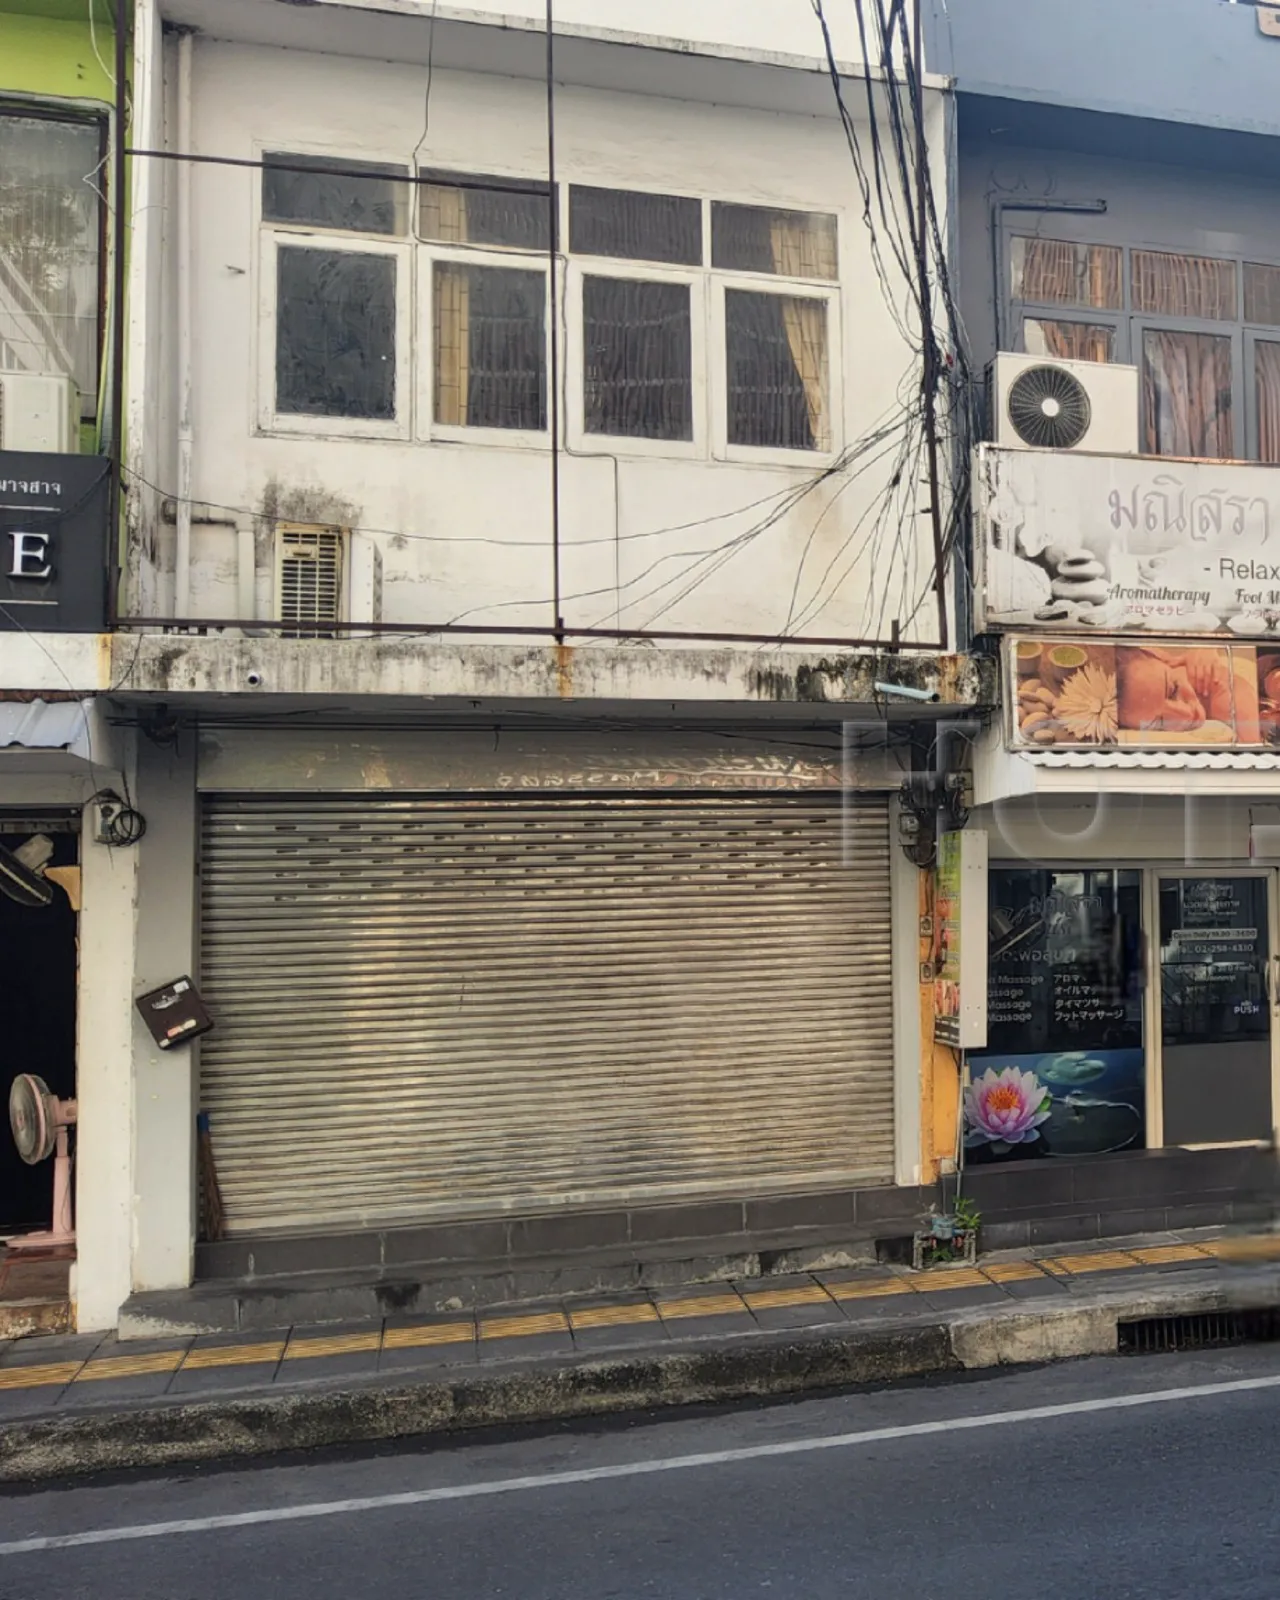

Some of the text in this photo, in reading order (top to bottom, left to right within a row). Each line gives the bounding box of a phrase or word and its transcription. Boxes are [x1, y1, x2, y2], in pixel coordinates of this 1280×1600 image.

[6, 531, 52, 578] E
[1107, 584, 1211, 606] Aromatherapy
[1234, 588, 1264, 604] Foot
[1234, 1005, 1260, 1015] PUSH
